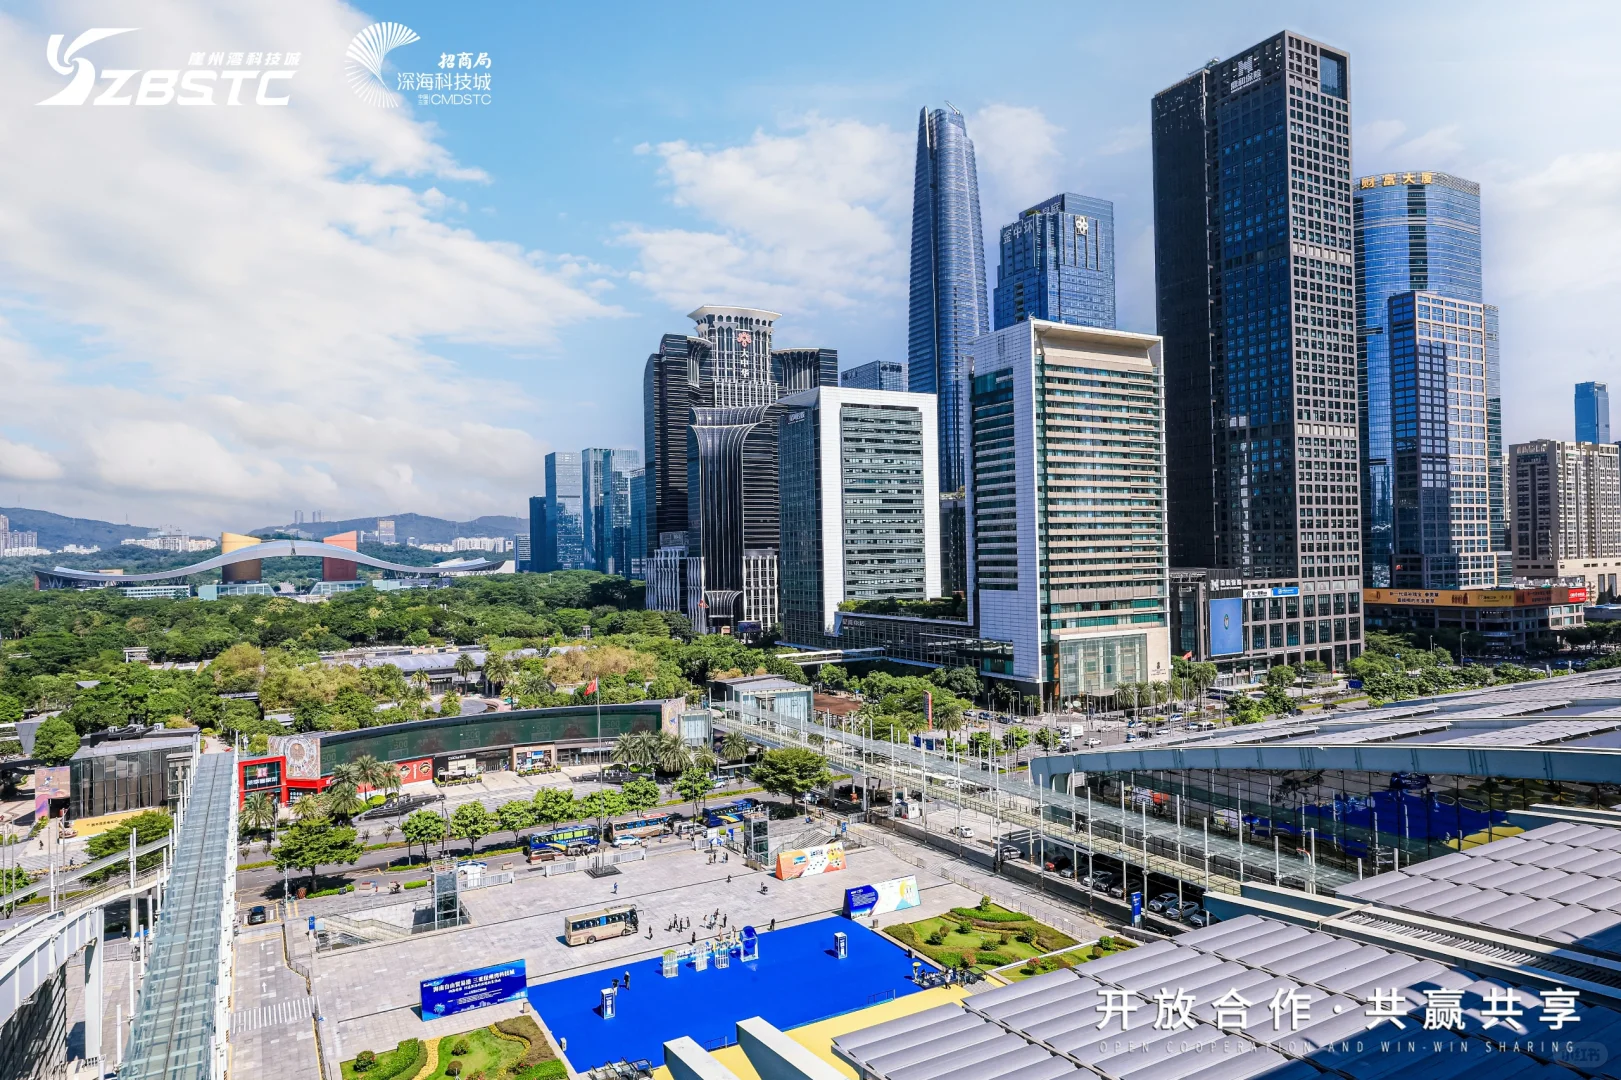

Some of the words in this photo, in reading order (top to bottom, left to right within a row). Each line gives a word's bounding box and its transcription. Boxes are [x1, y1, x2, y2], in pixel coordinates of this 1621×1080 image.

[1360, 171, 1434, 190] 财富大厦
[740, 347, 750, 379] 大中华
